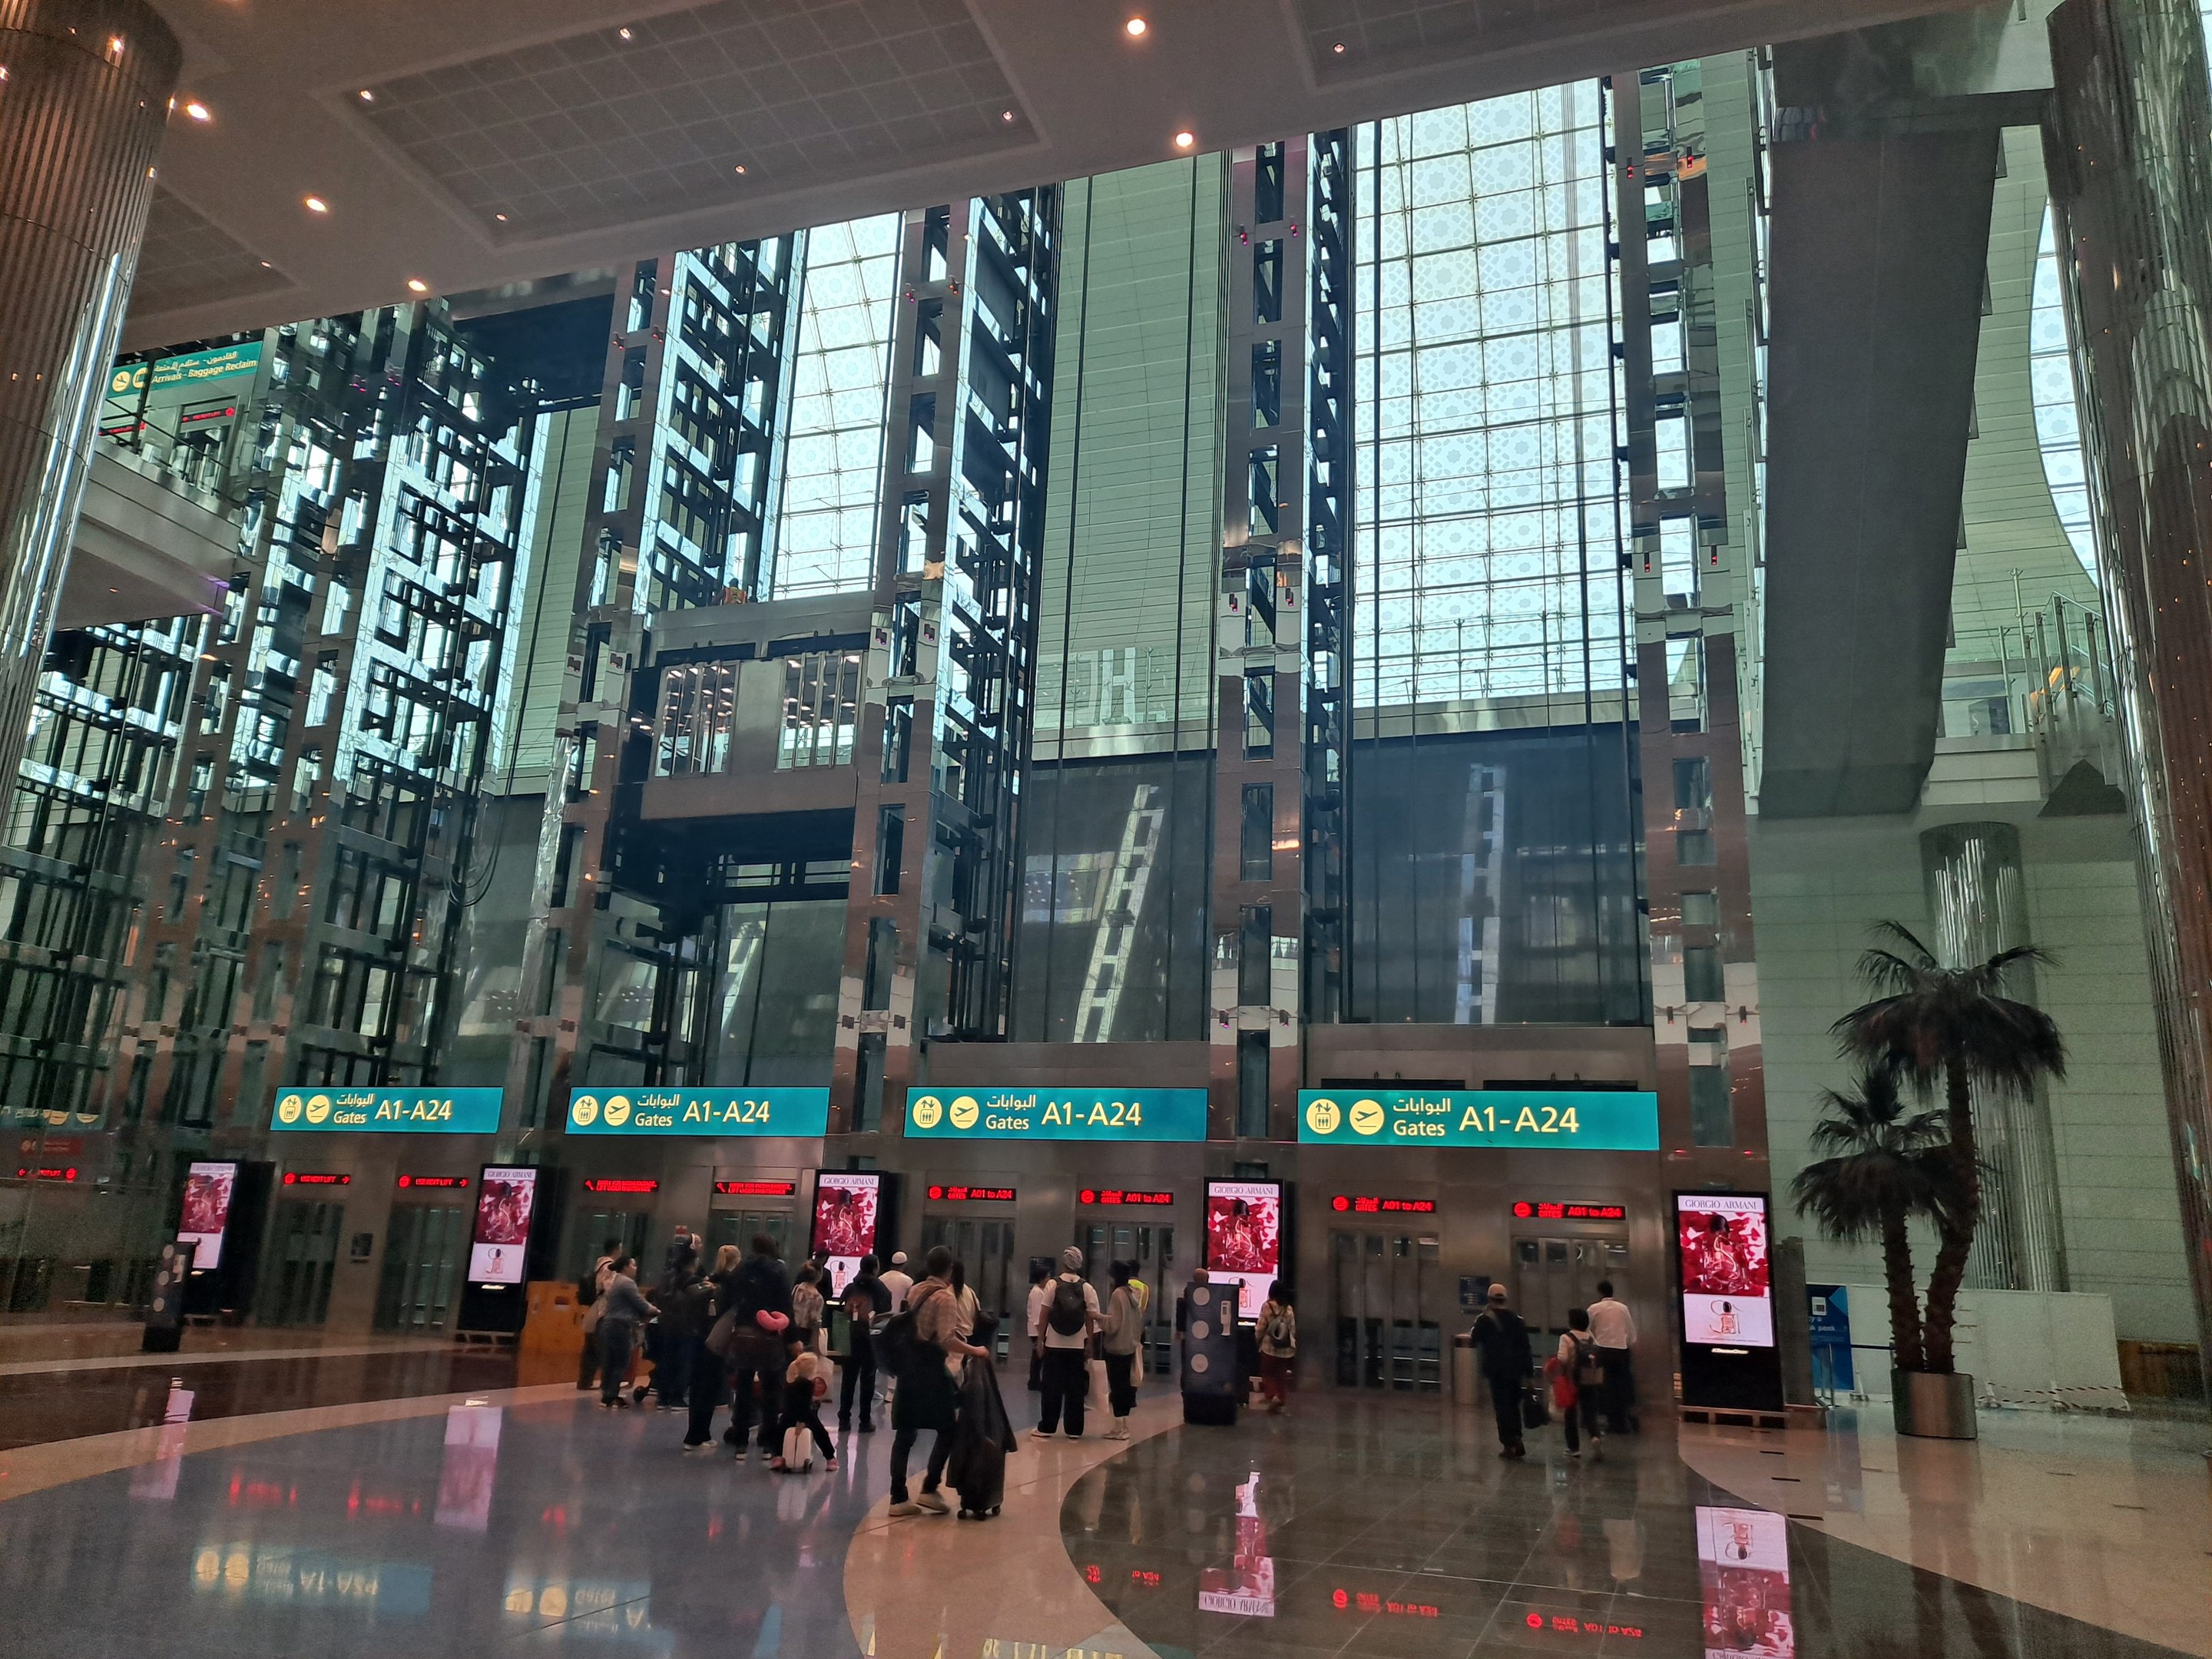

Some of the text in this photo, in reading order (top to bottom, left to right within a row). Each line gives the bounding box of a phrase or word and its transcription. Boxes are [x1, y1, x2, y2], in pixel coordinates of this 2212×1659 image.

[151, 373, 181, 384] Arrivals
[188, 366, 224, 379] Baggage
[225, 359, 257, 372] Reclaim
[336, 1093, 374, 1108] البوابات
[637, 1094, 680, 1109] البوابات
[987, 1094, 1036, 1111] البوابات
[1392, 1098, 1451, 1115] البوابات
[333, 1111, 366, 1124] Gates
[375, 1099, 452, 1121] A1-A24
[682, 1100, 770, 1123] A1-A24
[1041, 1101, 1143, 1127] A1-A24
[634, 1112, 673, 1127] Gates
[985, 1114, 1029, 1130] Gates
[1459, 1106, 1580, 1133] A1-A24
[1393, 1119, 1445, 1137] Gates
[971, 1190, 985, 1198] A01
[996, 1190, 1012, 1199] A24
[1214, 1186, 1273, 1195] GIORGIO ARMANI
[1125, 1194, 1141, 1202] A01
[1153, 1194, 1170, 1204] A24
[1382, 1200, 1401, 1210] A01
[1413, 1202, 1433, 1211] A24
[1684, 1199, 1757, 1210] GIORGIO ARMANI
[1568, 1207, 1622, 1218] A01 to A24
